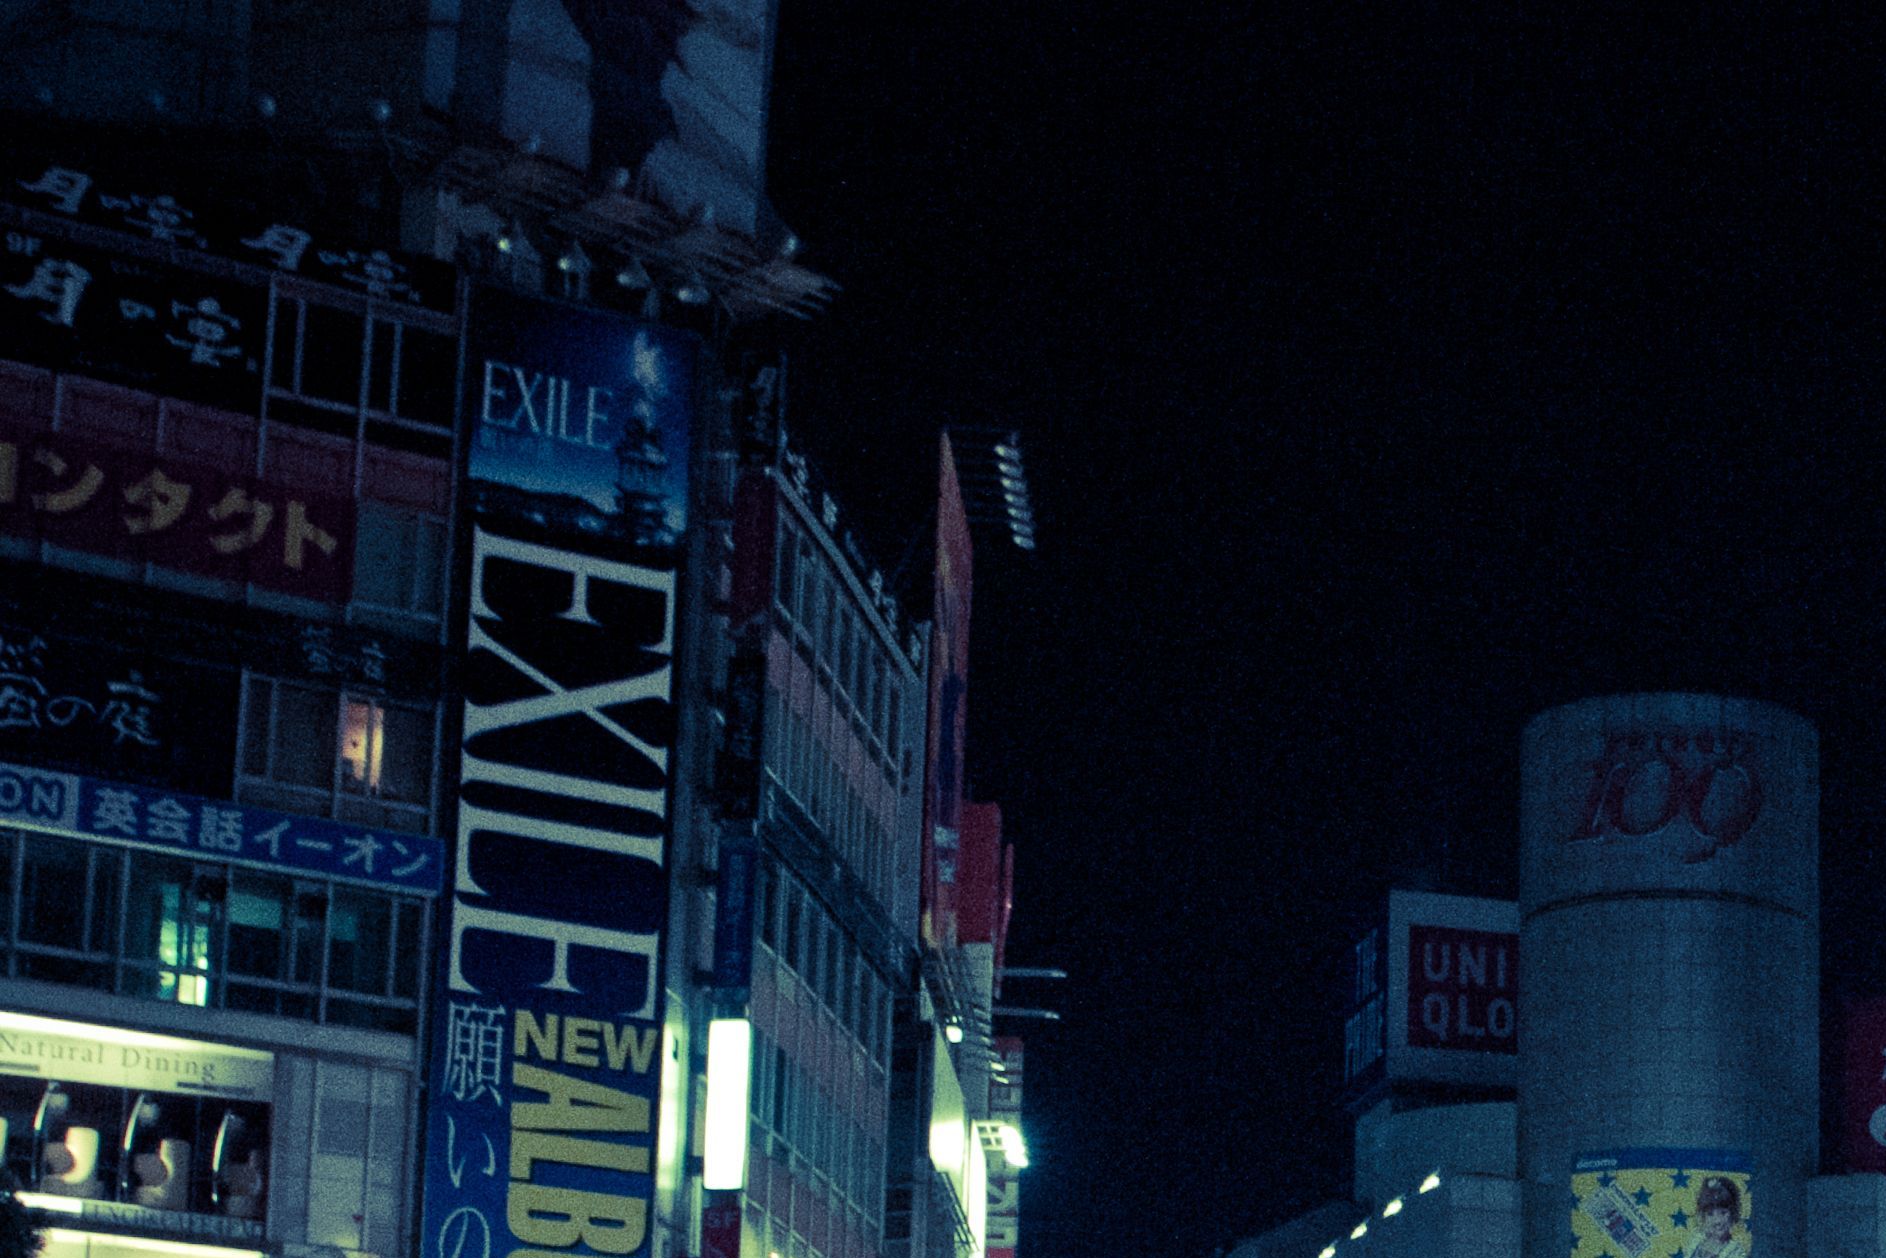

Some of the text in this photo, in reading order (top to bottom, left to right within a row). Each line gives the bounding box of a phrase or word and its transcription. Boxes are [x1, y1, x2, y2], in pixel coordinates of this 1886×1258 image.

[481, 358, 618, 449] EXILE
[449, 522, 678, 1021] EXILE
[1568, 752, 1765, 864] 109
[92, 786, 432, 880] 英会話イーオン
[1422, 941, 1509, 989] UNI
[0, 1032, 217, 1083] Natural Dining
[511, 1007, 659, 1076] NEW
[1421, 992, 1516, 1043] QLO
